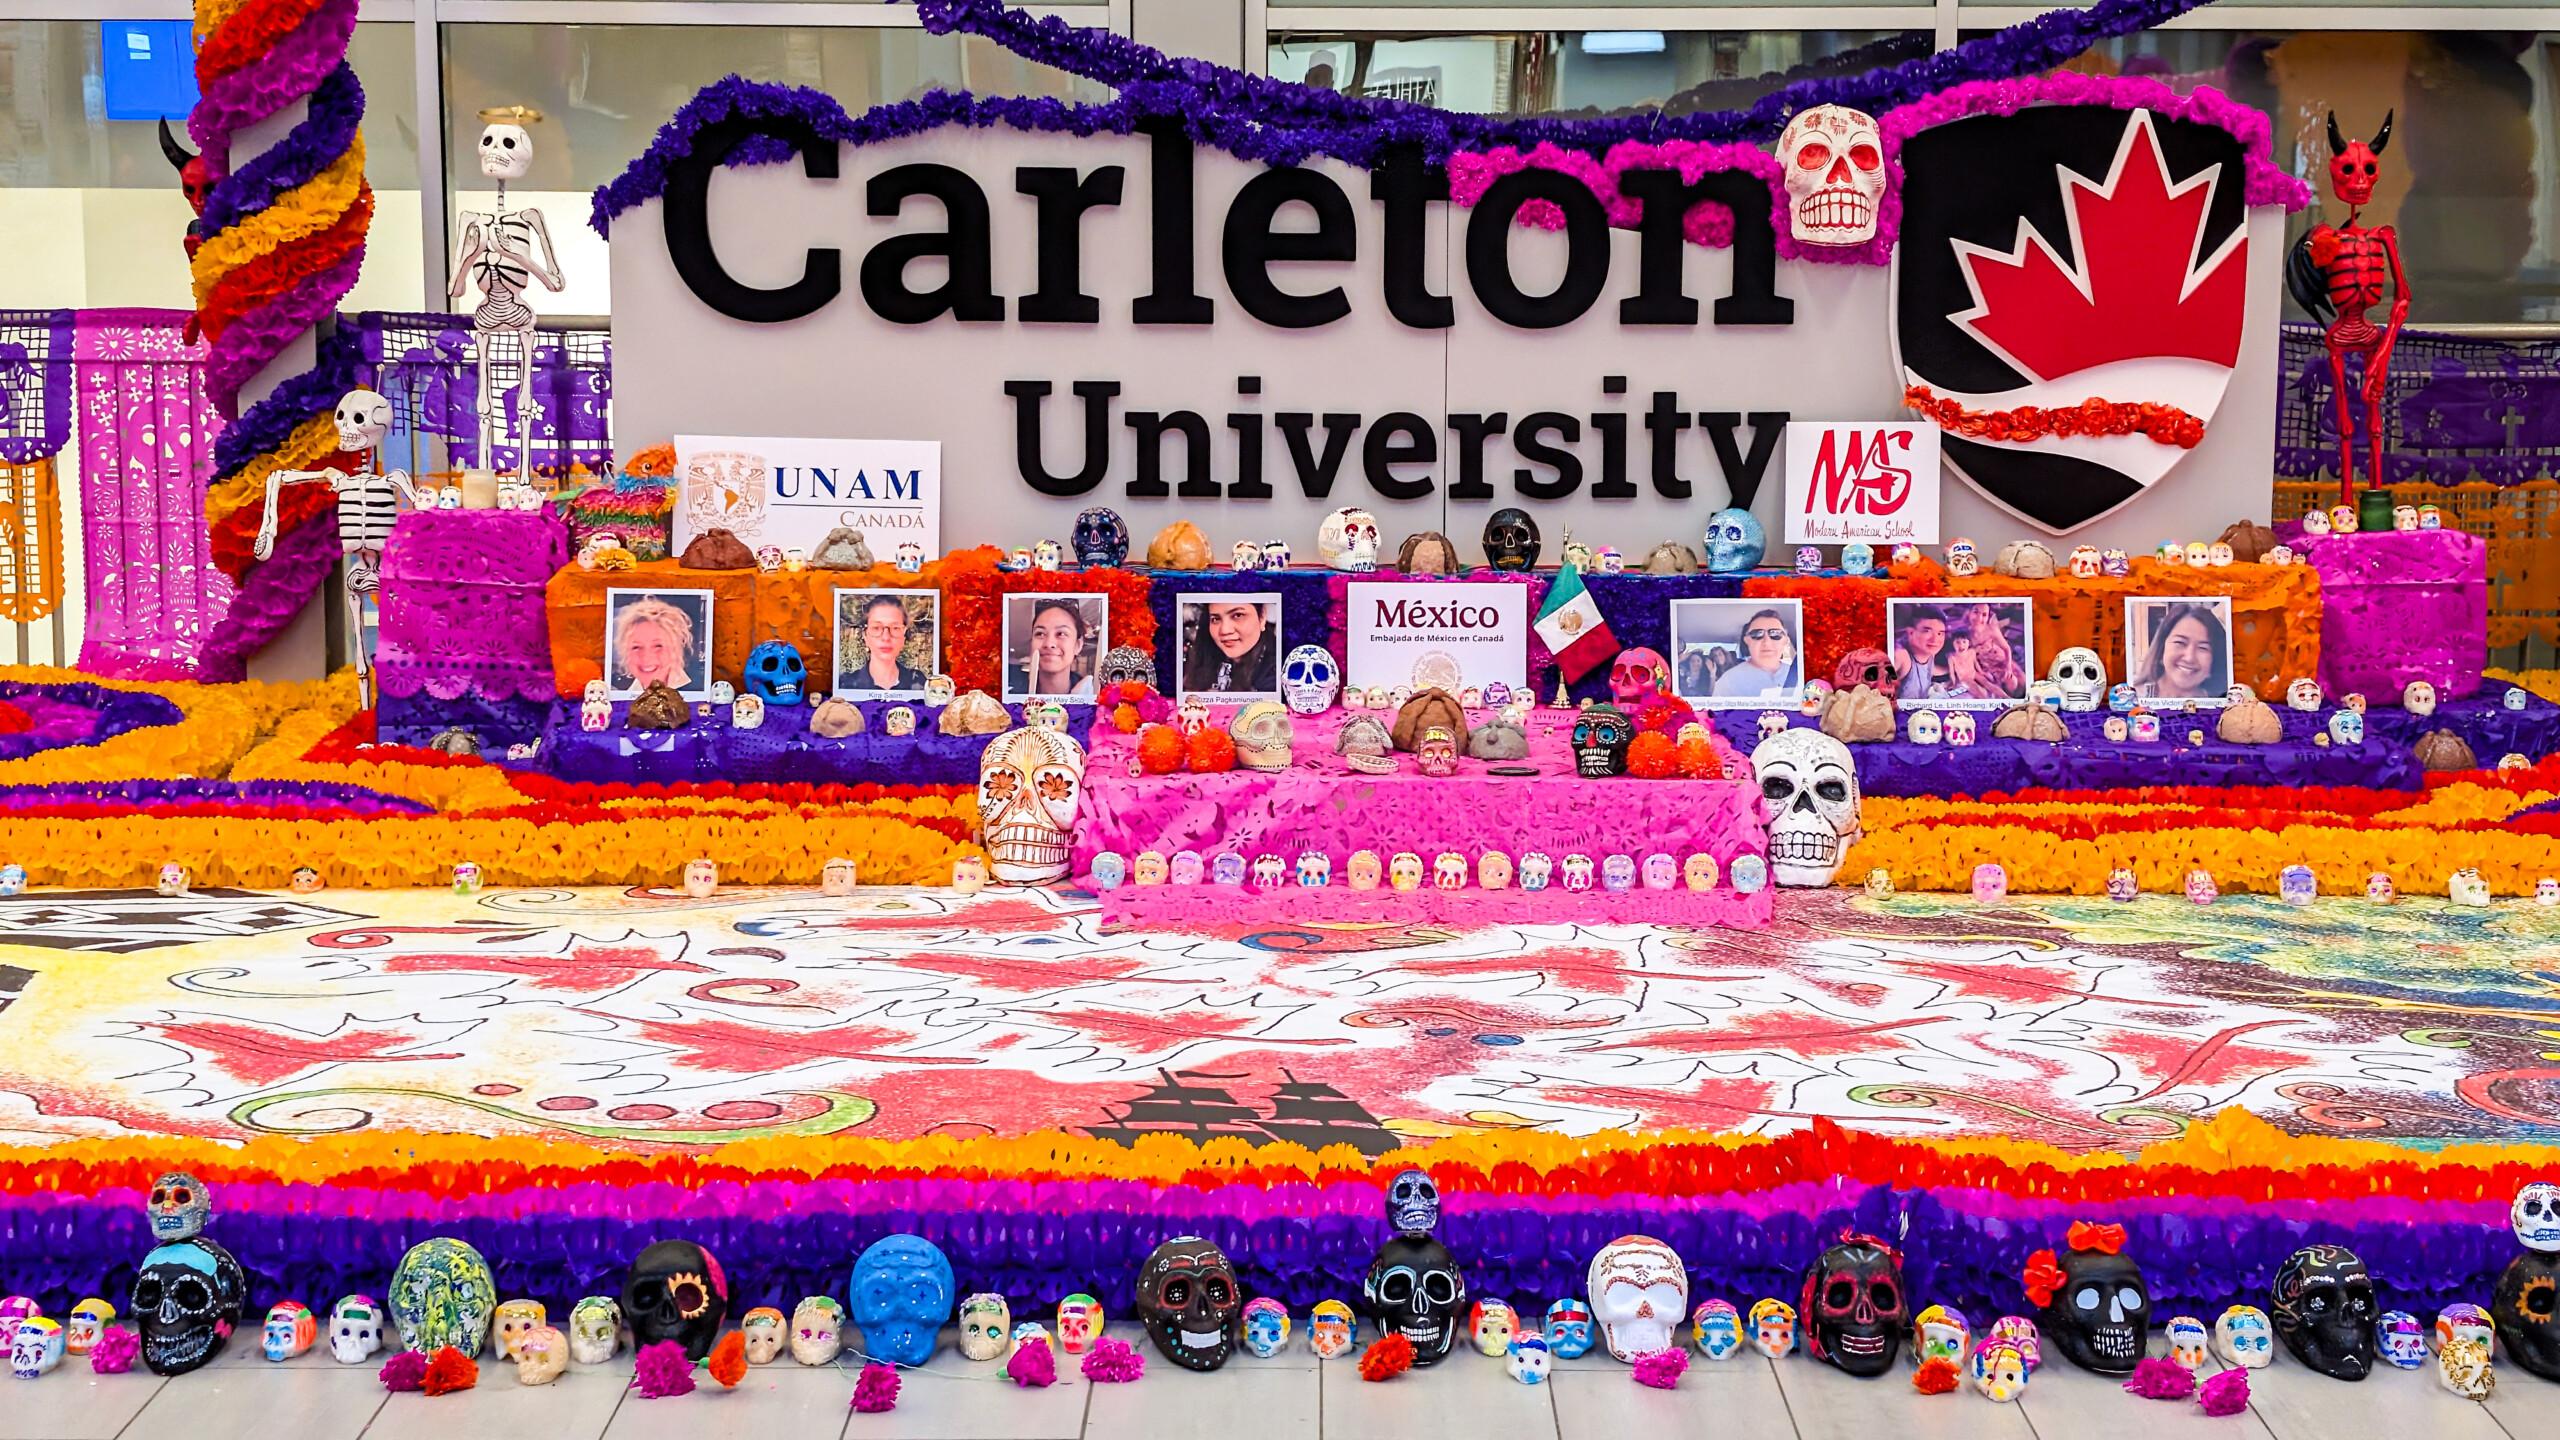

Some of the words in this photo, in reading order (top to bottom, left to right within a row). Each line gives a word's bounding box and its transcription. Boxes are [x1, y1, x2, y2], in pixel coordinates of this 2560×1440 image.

[663, 113, 1794, 329] Carleton
[1004, 375, 1790, 516] University
[773, 467, 923, 500] UNAM
[1805, 429, 1914, 516] MAS
[840, 511, 926, 529] CANADÁ
[1804, 519, 1838, 538] Modern
[1841, 520, 1881, 539] American
[1885, 520, 1915, 539] School
[1375, 600, 1499, 628] México
[1370, 634, 1412, 643] Embajada
[1414, 634, 1425, 642] de
[1427, 634, 1457, 642] México
[1472, 634, 1504, 642] Canadá
